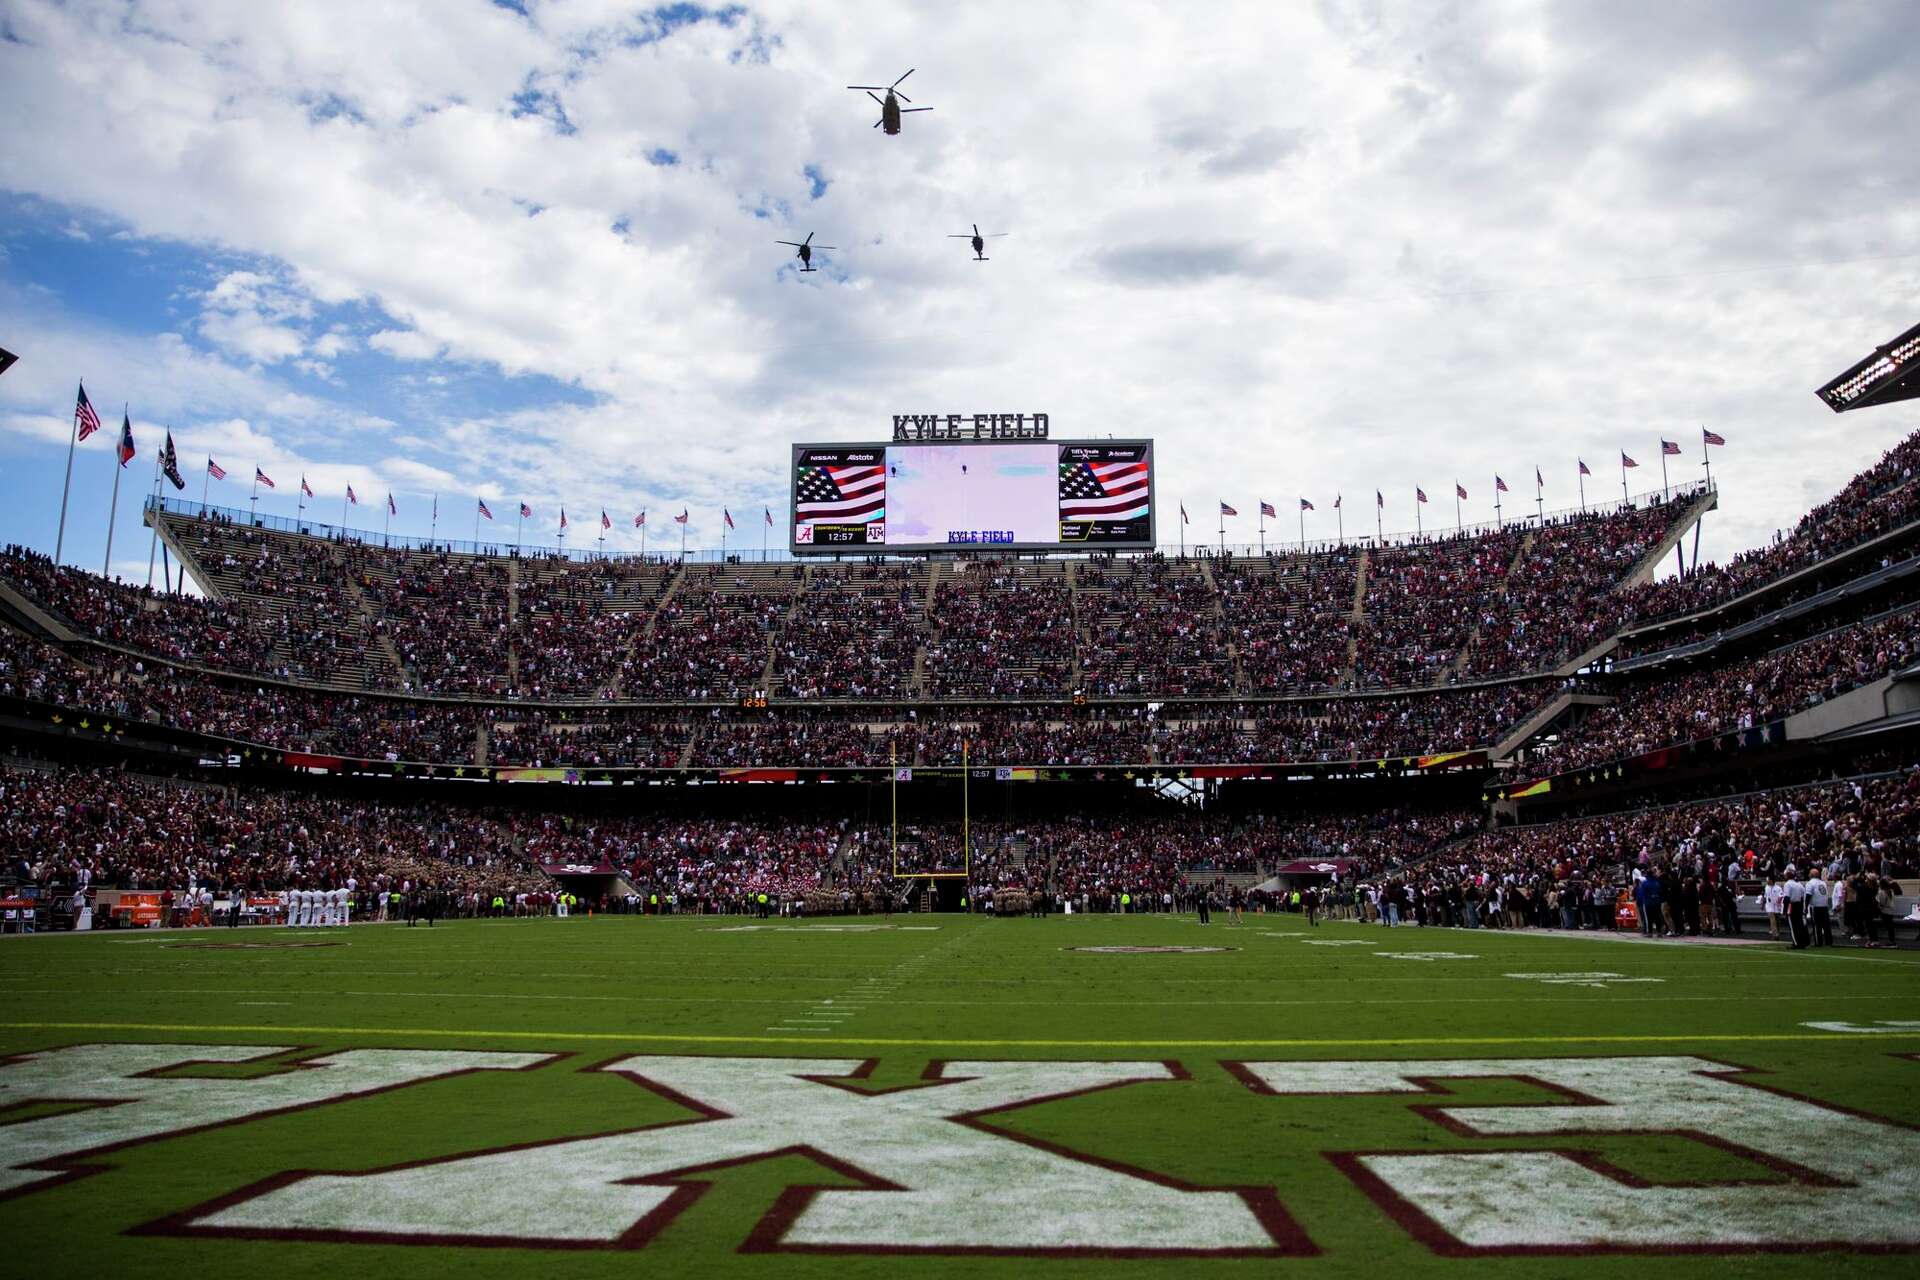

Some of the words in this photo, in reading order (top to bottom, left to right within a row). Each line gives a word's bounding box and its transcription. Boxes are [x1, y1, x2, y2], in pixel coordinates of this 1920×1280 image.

[892, 414, 962, 439] KYLE
[973, 413, 1049, 439] FIELD
[828, 533, 854, 541] 12:57
[948, 531, 978, 543] KYLE
[982, 531, 1015, 543] FIELD
[743, 698, 766, 707] 12:56
[1073, 695, 1086, 705] 25
